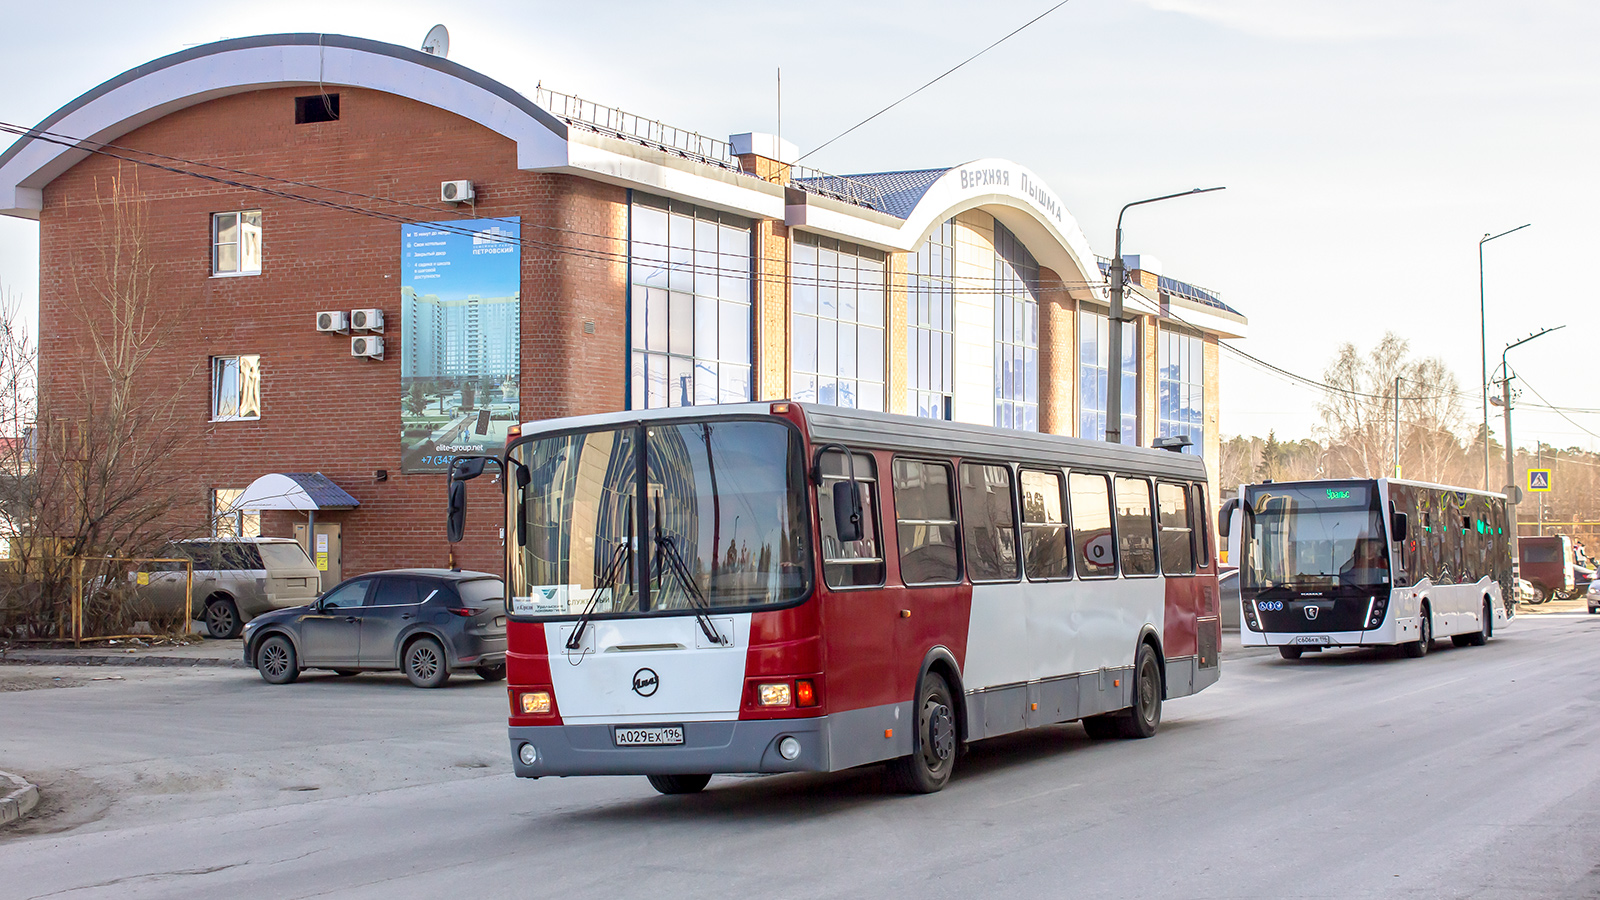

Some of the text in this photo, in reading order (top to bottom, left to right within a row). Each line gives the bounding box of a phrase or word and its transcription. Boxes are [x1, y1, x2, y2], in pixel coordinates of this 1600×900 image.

[472, 246, 514, 255] ПЕТРОВСКИЙ
[435, 444, 484, 453] elite-group.net
[421, 455, 432, 465] +7
